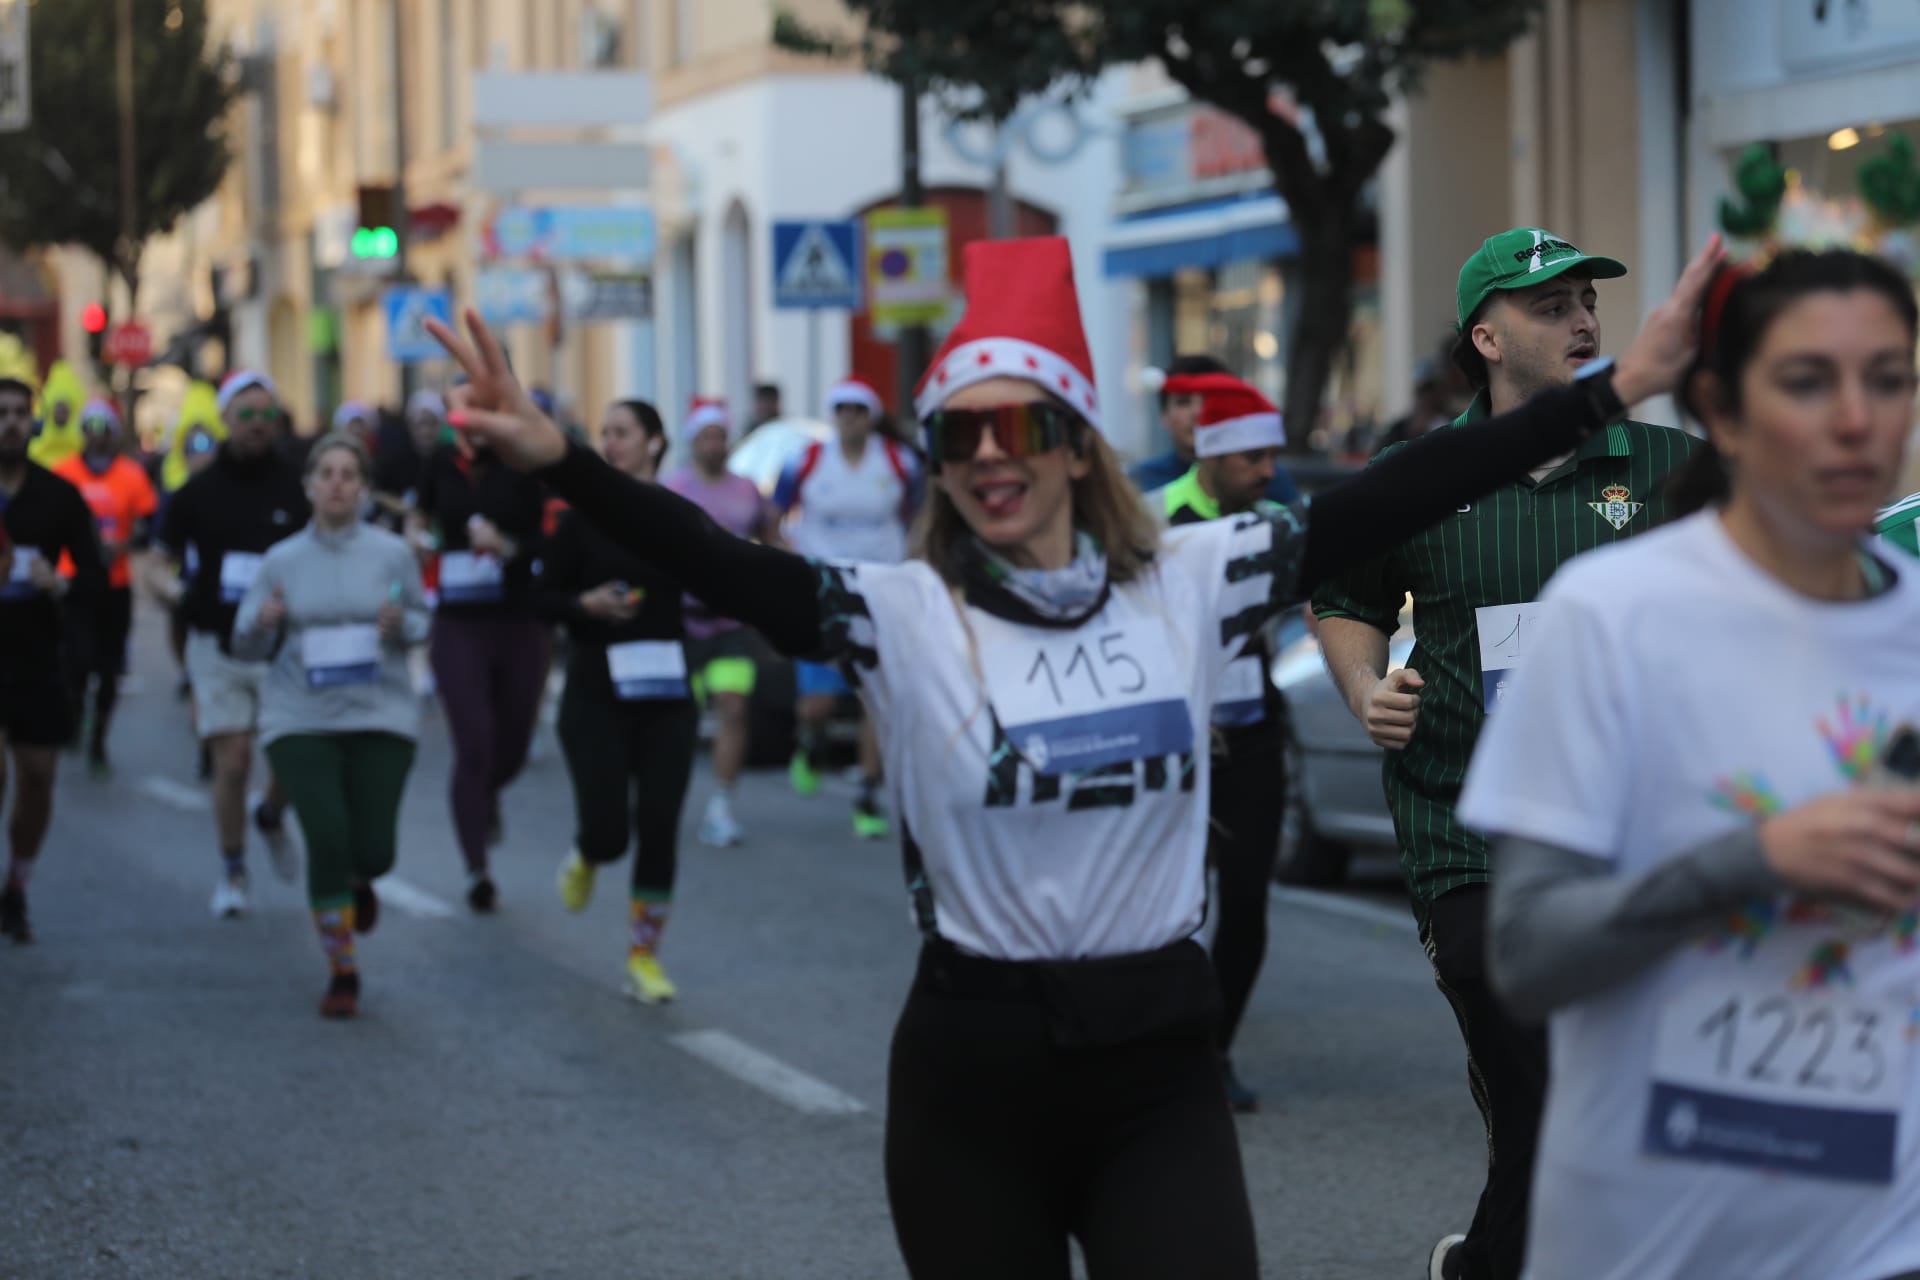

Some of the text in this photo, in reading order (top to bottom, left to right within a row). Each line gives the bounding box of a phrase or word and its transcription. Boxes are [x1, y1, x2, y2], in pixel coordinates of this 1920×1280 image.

[1514, 240, 1552, 263] Real
[1027, 631, 1147, 705] 115
[1698, 996, 1887, 1095] 1223
